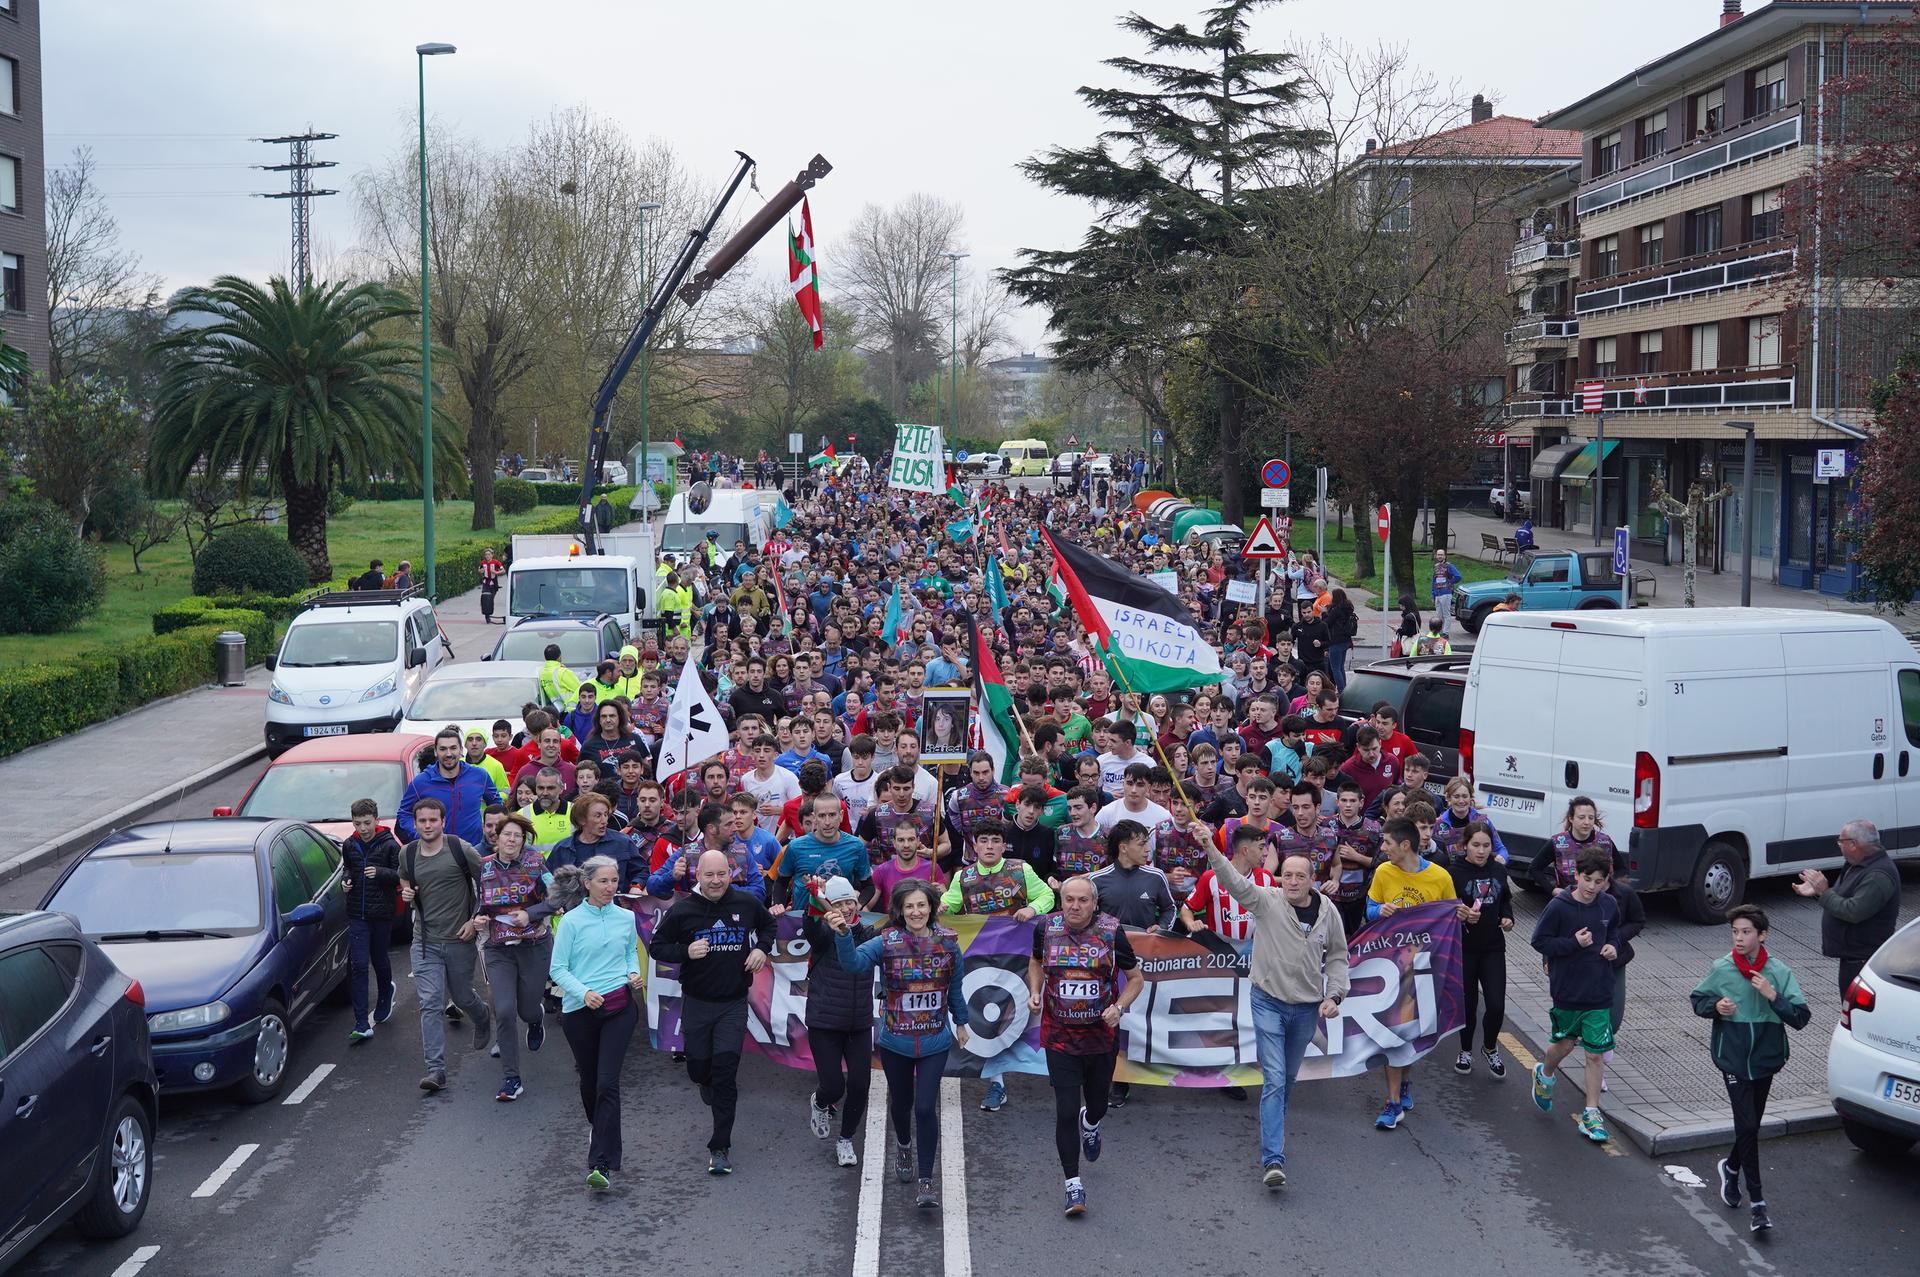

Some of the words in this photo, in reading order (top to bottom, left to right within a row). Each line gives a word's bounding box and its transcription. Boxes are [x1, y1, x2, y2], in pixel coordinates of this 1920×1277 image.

[1115, 608, 1196, 641] ISRAELI
[1674, 682, 1684, 695] 31
[310, 727, 329, 735] 1924
[331, 726, 346, 734] KFW
[1498, 772, 1525, 780] PEUGEOT
[1608, 786, 1630, 796] BOXER
[1493, 795, 1515, 810] 5081
[1517, 799, 1536, 813] JVH
[1395, 931, 1431, 948] 24ra
[1060, 982, 1099, 996] 1718
[909, 992, 937, 1009] 1718
